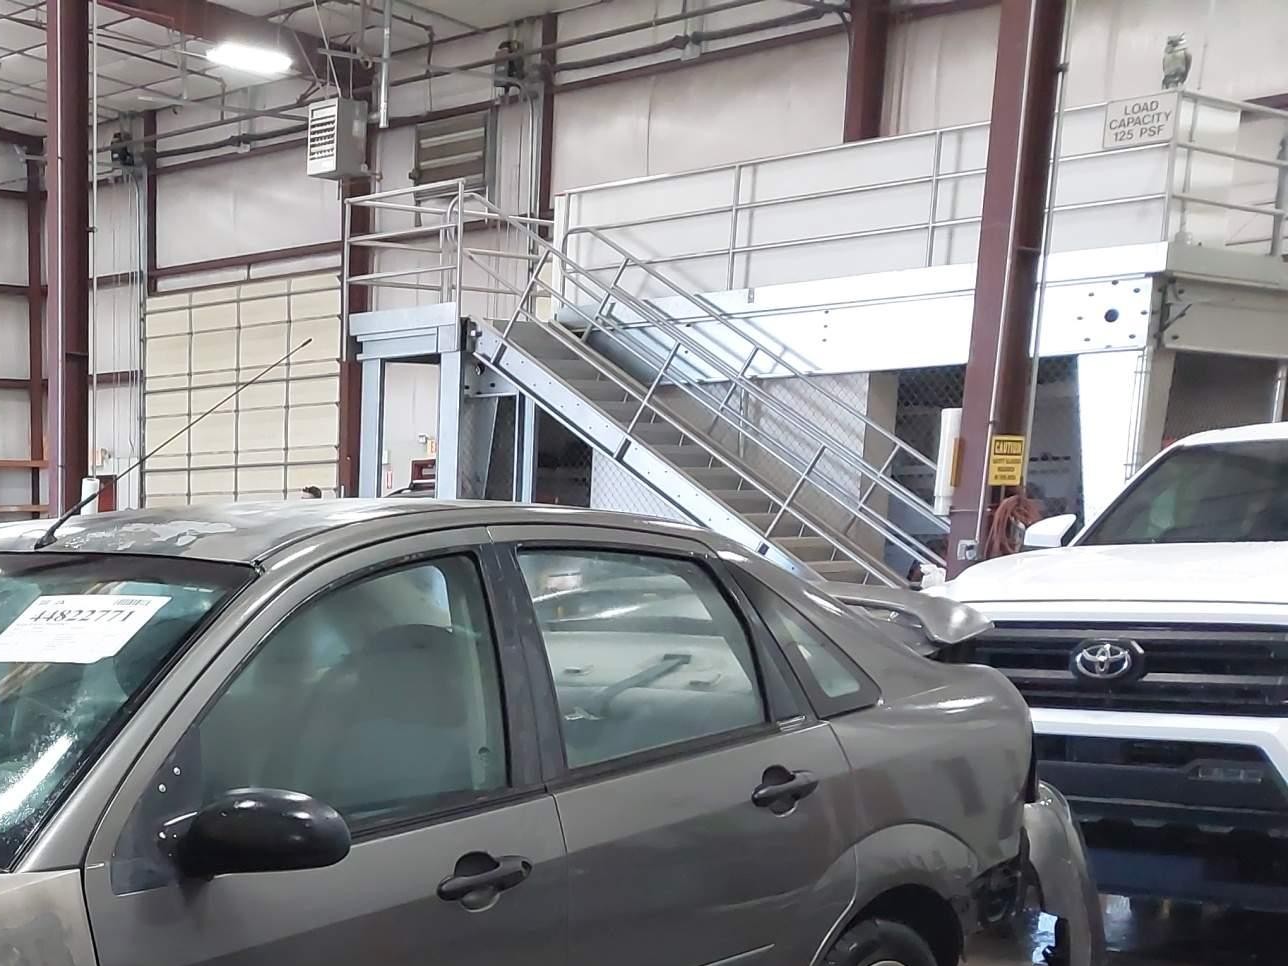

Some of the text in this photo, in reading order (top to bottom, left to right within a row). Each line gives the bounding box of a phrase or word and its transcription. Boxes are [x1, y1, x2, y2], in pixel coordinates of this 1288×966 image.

[1124, 100, 1159, 116] LOAD
[1109, 110, 1173, 130] CAPACITY
[1114, 124, 1166, 142] 125 PSF
[29, 609, 136, 622] 44822771
